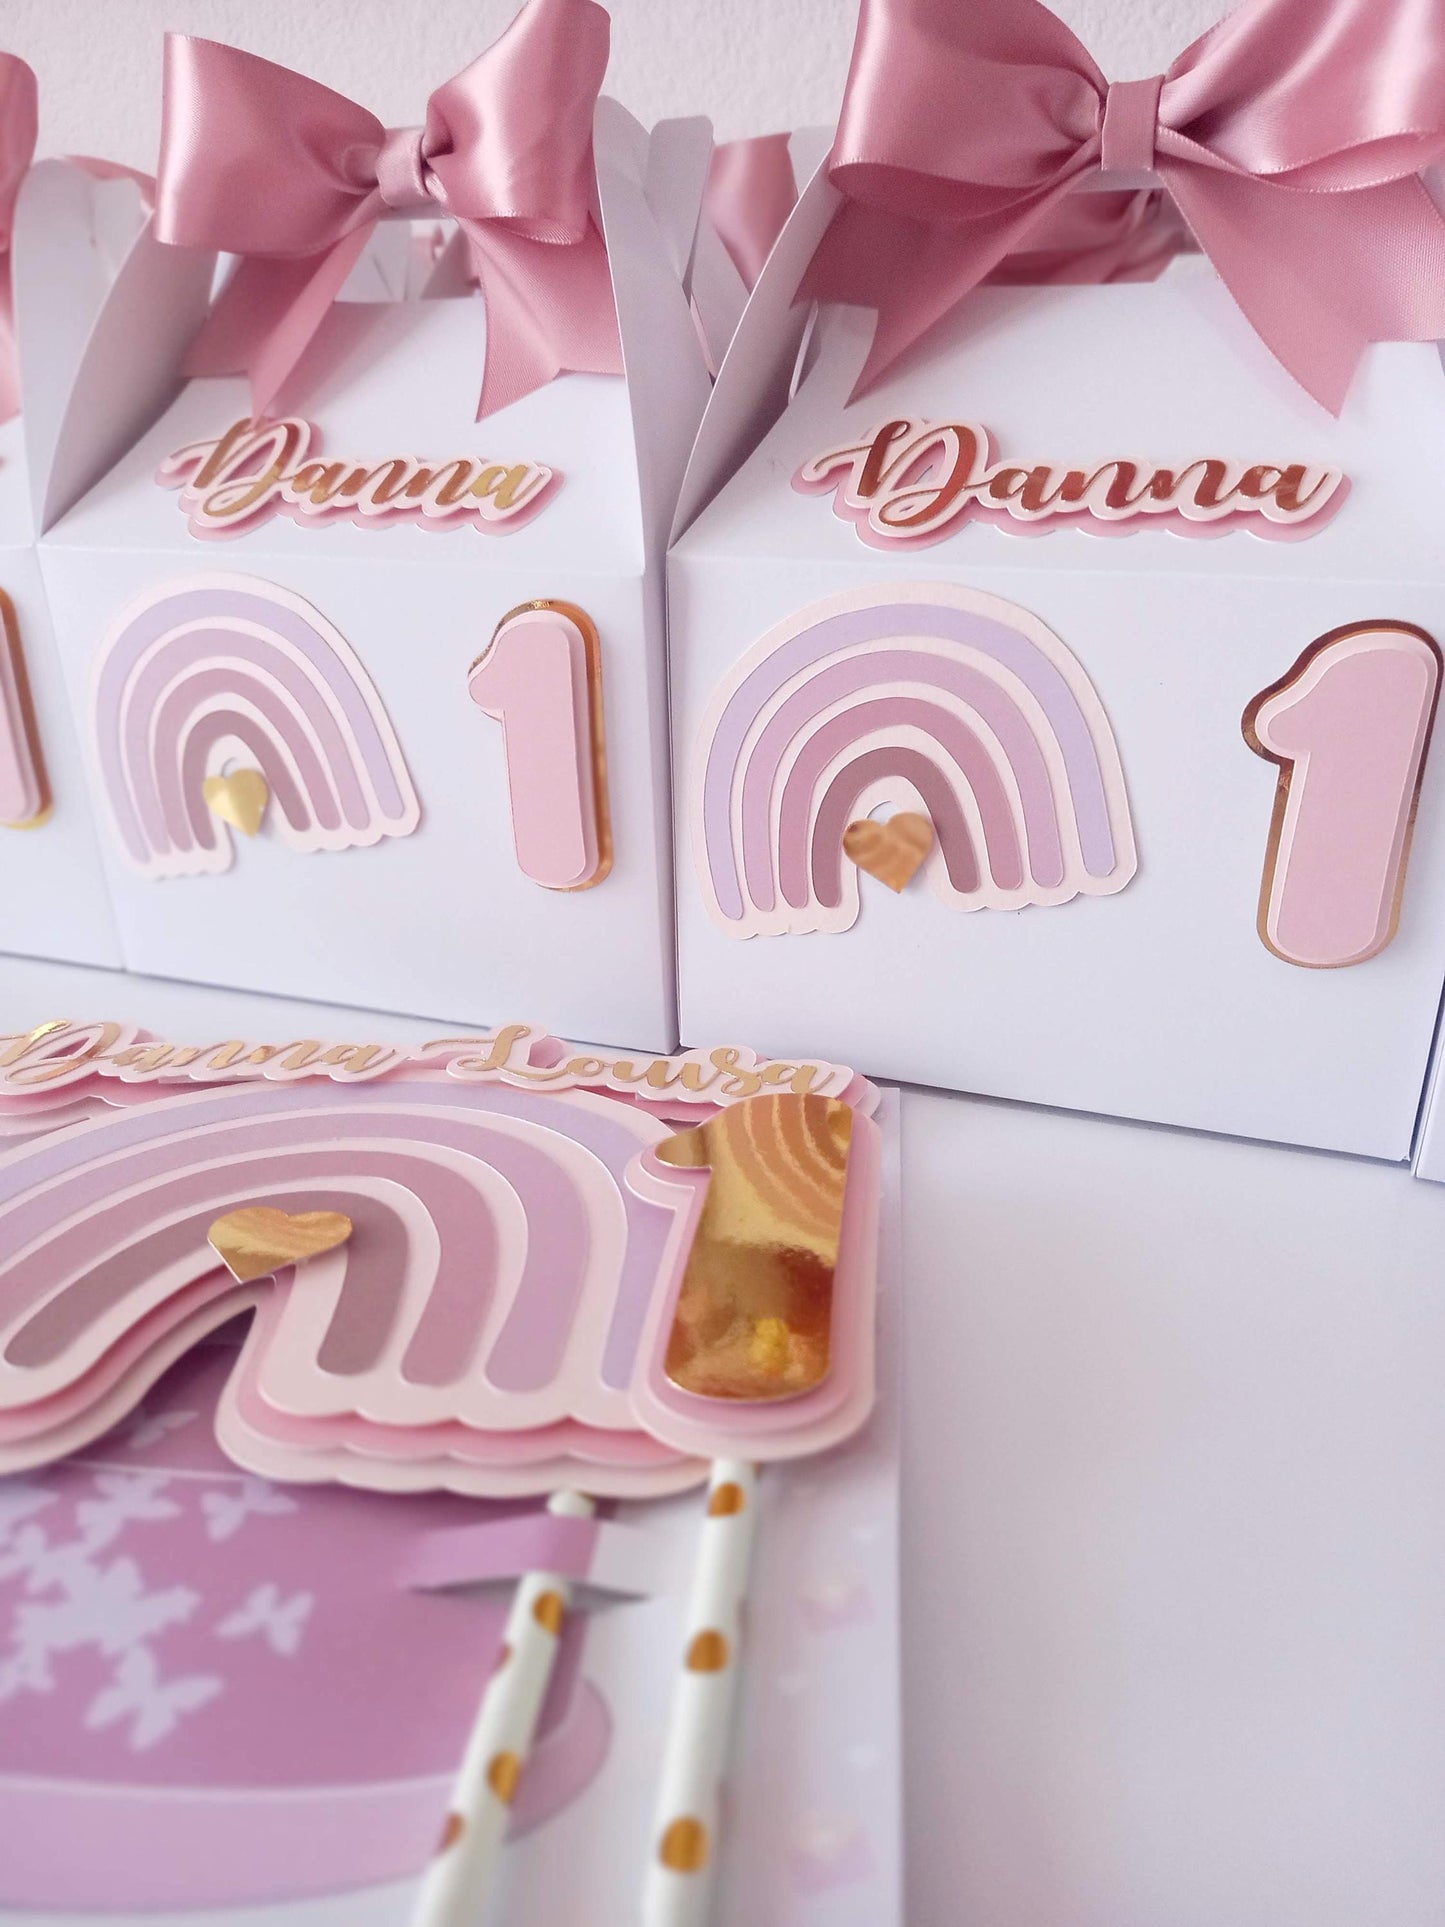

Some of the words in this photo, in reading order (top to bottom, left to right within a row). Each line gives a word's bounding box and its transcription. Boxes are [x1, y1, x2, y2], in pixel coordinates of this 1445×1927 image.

[170, 417, 547, 518] Danna
[810, 419, 1330, 529] Danna
[467, 598, 615, 893] 1
[1240, 618, 1445, 970] 1
[0, 1019, 397, 1086] Danna
[655, 1093, 854, 1400] 1
